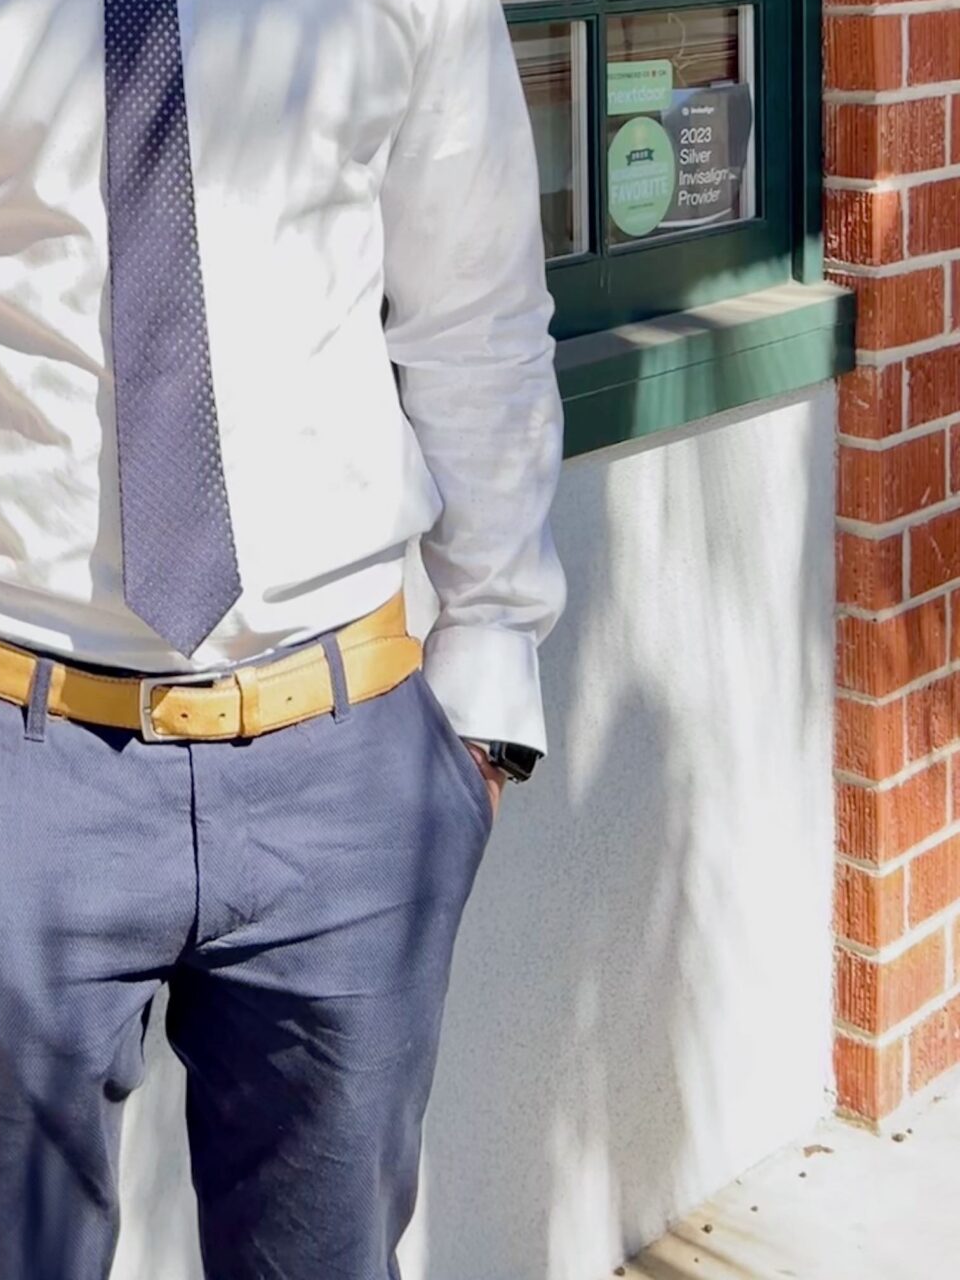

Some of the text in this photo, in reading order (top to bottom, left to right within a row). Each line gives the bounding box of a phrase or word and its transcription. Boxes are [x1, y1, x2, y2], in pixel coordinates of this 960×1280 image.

[680, 126, 712, 145] 2023
[680, 147, 712, 165] Silver
[679, 167, 729, 186] Invisalign
[678, 187, 721, 207] Provider
